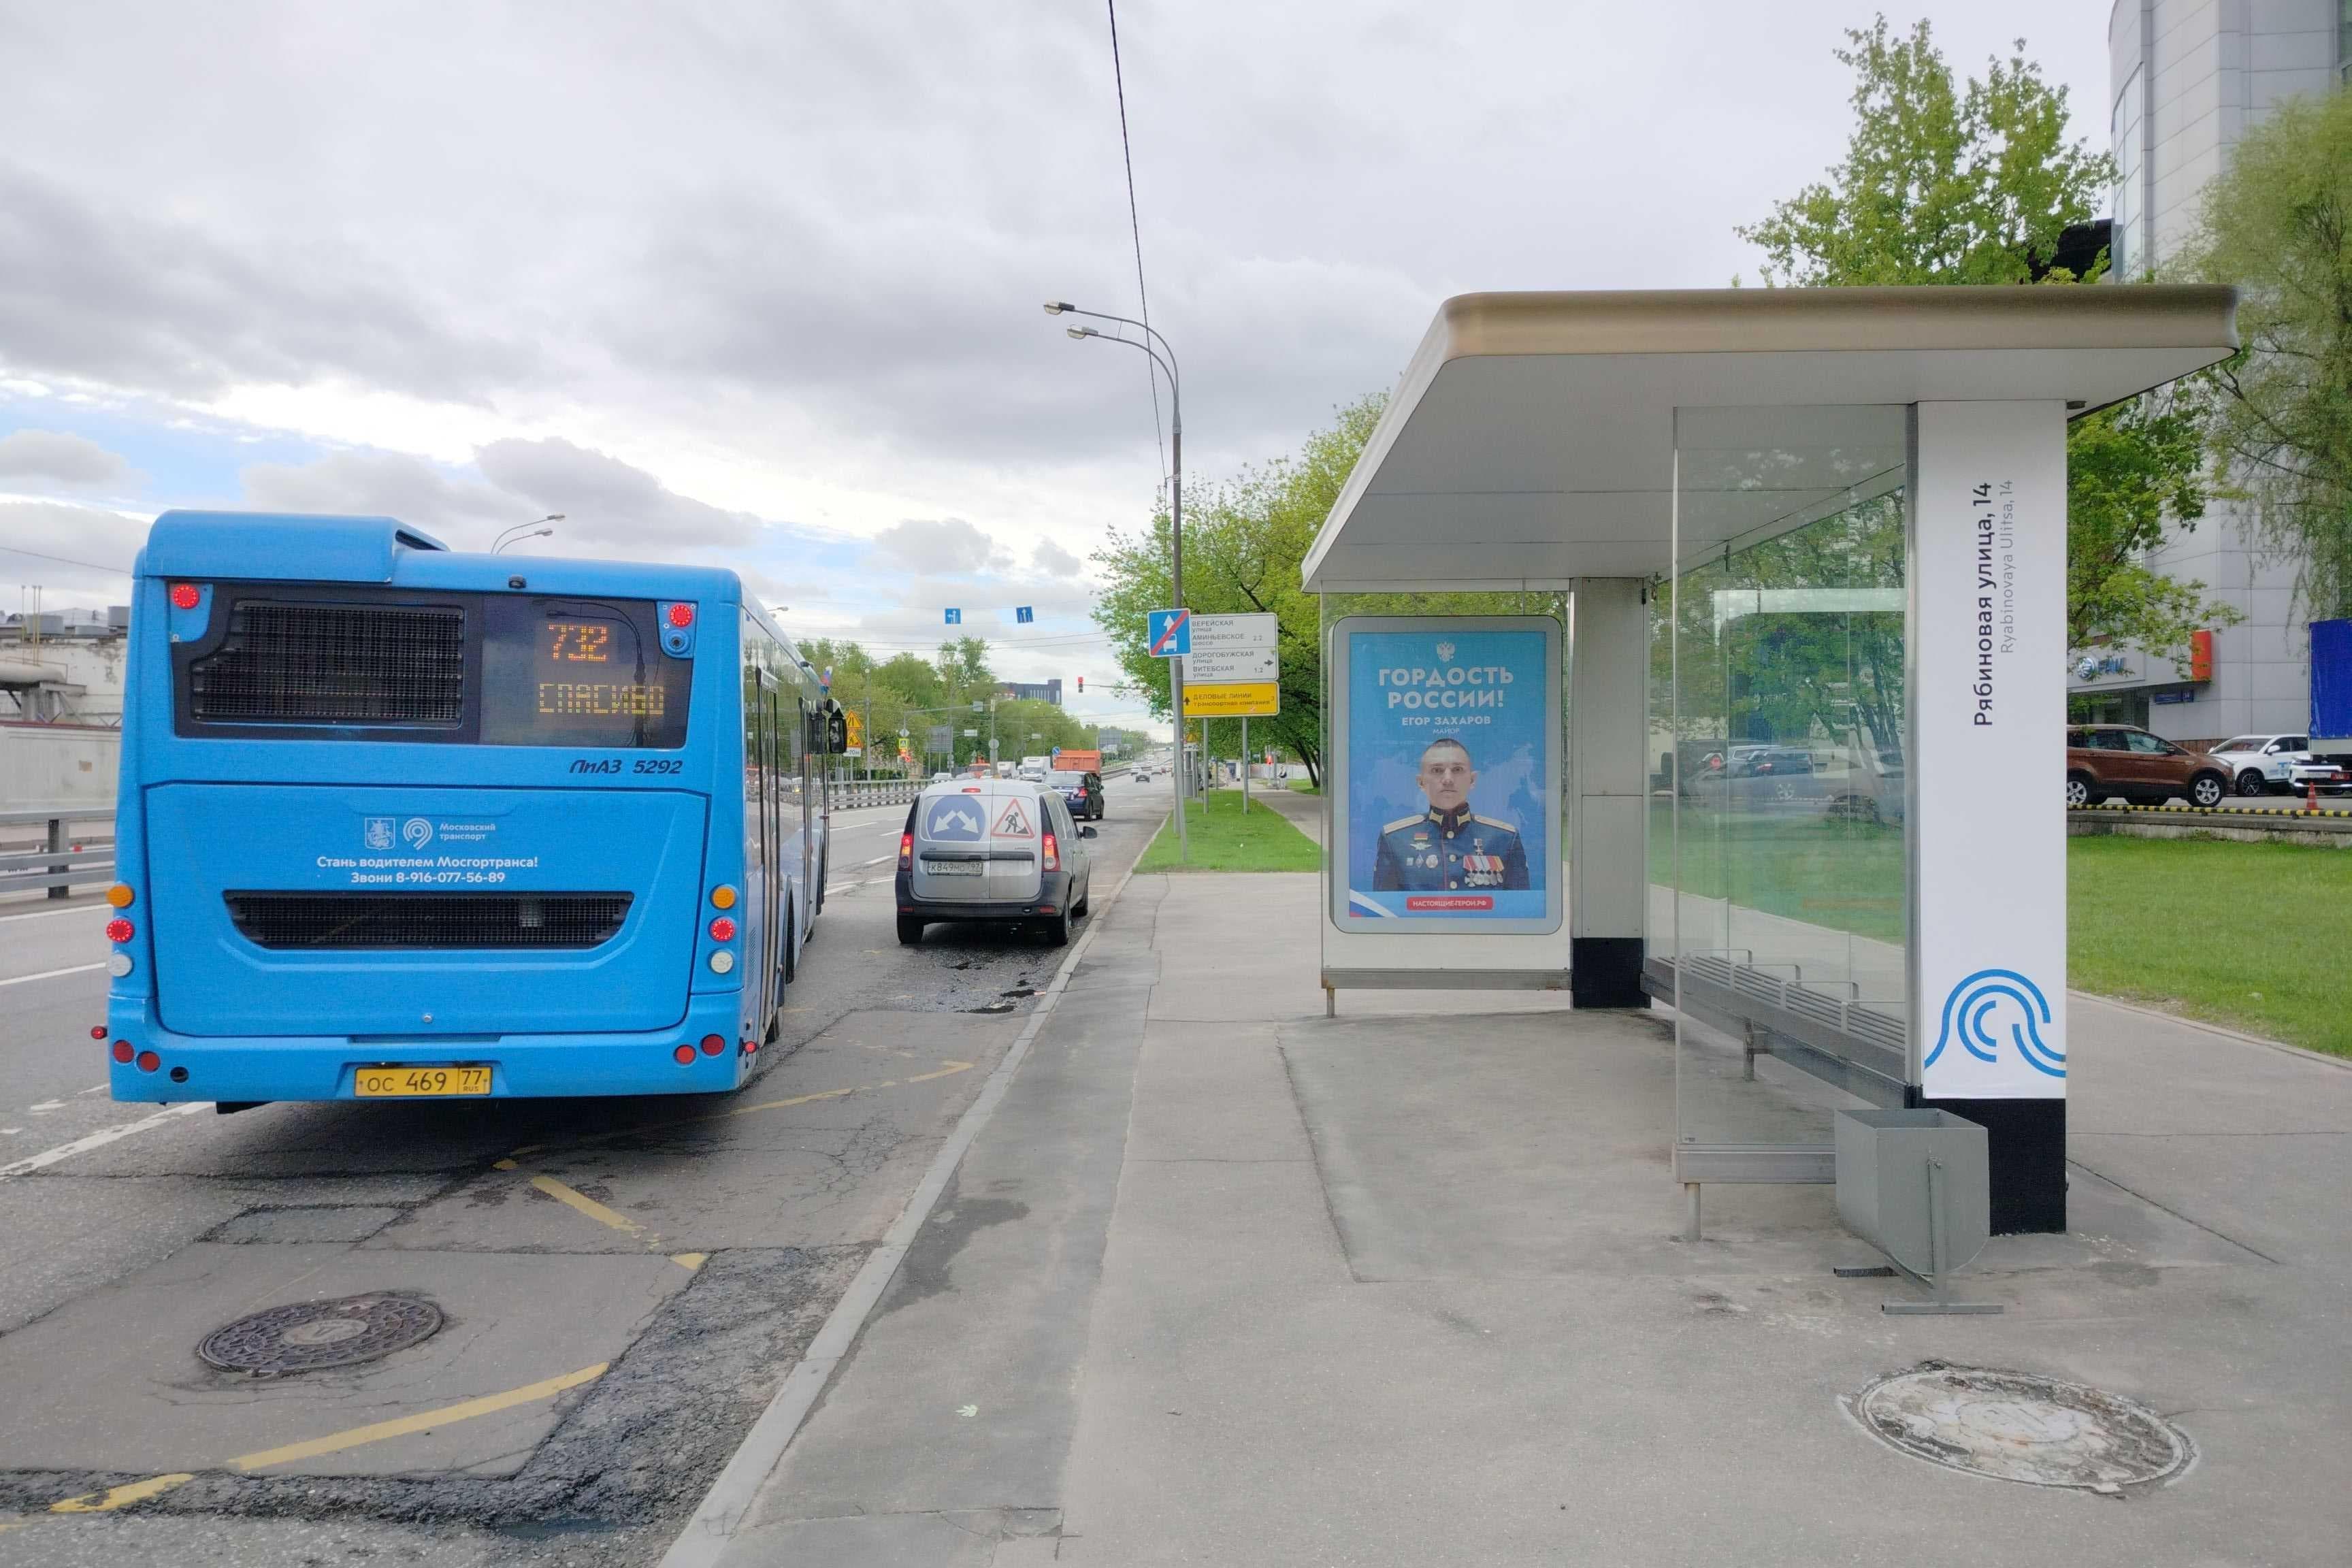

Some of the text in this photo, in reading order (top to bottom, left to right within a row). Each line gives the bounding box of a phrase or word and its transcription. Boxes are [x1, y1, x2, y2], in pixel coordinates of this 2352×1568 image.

[1999, 480, 2016, 654] Ryabinovaya Ulitsa, 14
[1972, 483, 1997, 726] Рябиновая улица, 14
[549, 623, 607, 662] 732
[1192, 651, 1254, 659] ДОРОГОБУЖСКАЯ
[1379, 667, 1514, 687] ГОРДОСТЬ
[539, 683, 665, 715] СПАСИБО
[1388, 690, 1504, 708] РОССИИ!
[1401, 715, 1491, 726] ЕГОР ЗАХАРОВ
[1433, 726, 1460, 735] МАЙОР
[569, 760, 683, 774] ЛиАЗ 5292
[439, 822, 496, 831] Московский
[440, 832, 486, 841] транспорт
[316, 856, 538, 870] Стань водителем Мосгортранса!
[350, 872, 505, 883] Звони 8-916-077-56-89
[406, 1071, 447, 1092] 469
[461, 1070, 483, 1085] 77
